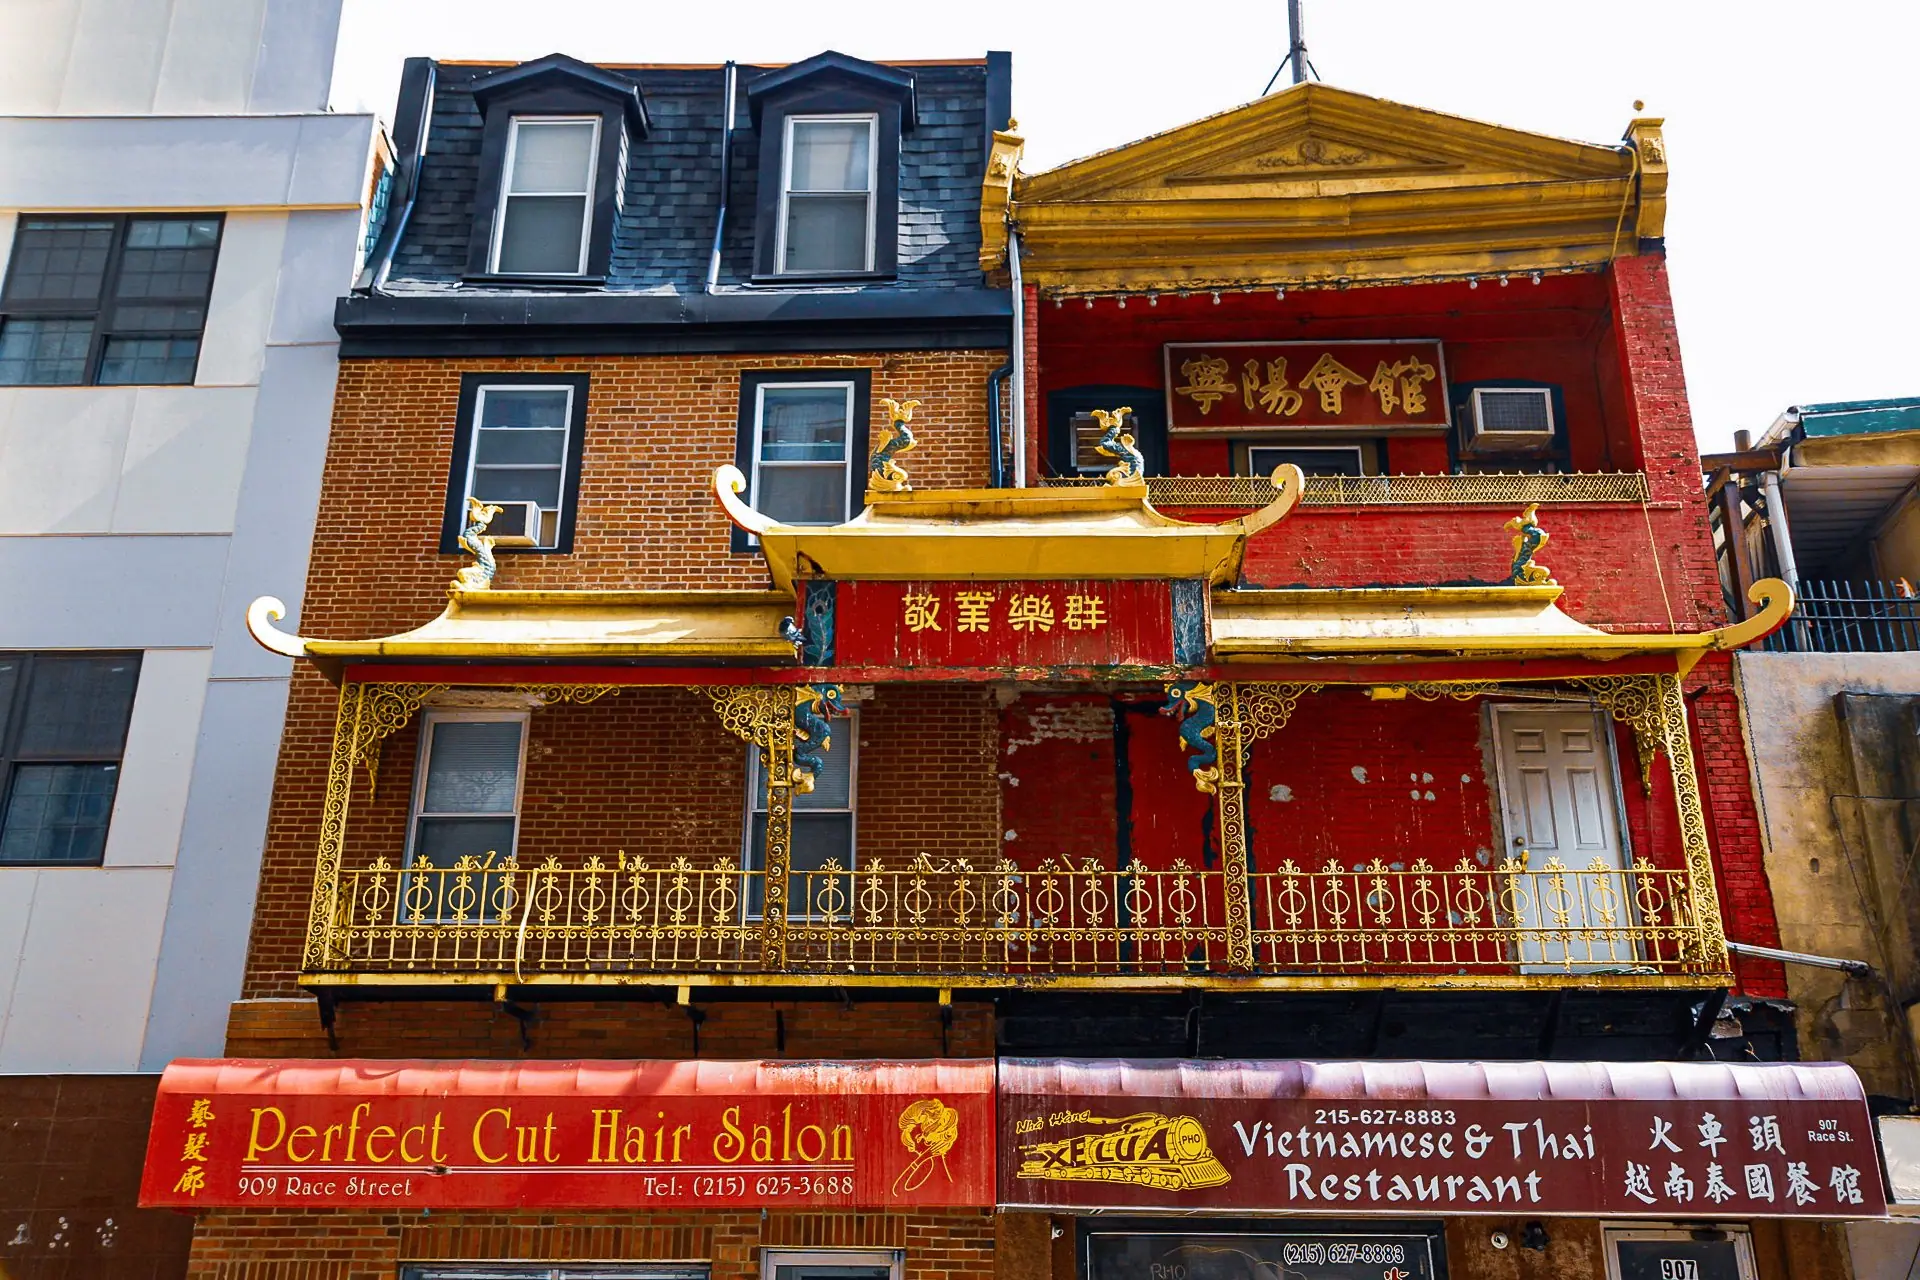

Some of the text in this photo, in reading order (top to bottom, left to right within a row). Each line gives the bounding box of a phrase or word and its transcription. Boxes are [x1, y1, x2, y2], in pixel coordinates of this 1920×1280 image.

[901, 591, 1107, 633] 敬業樂群
[1314, 1108, 1457, 1126] 215-627-8883
[1818, 1119, 1838, 1131] 907
[242, 1102, 855, 1164] Perfect Cut Hair Salon
[1181, 1133, 1201, 1145] PHO
[1232, 1117, 1596, 1160] Vietnamese & Thai
[1648, 1111, 1787, 1158] 火車頭
[1807, 1130, 1854, 1142] Race St.
[172, 1098, 216, 1197] 藝髮廊
[238, 1176, 413, 1197] 909 Race Street
[643, 1175, 854, 1197] Tel: (215) 625-3688
[1282, 1163, 1543, 1203] Restaurant
[1623, 1160, 1865, 1206] 越南泰國餐館
[1283, 1243, 1404, 1266] (215) 627-8883
[1662, 1260, 1696, 1280] 907
